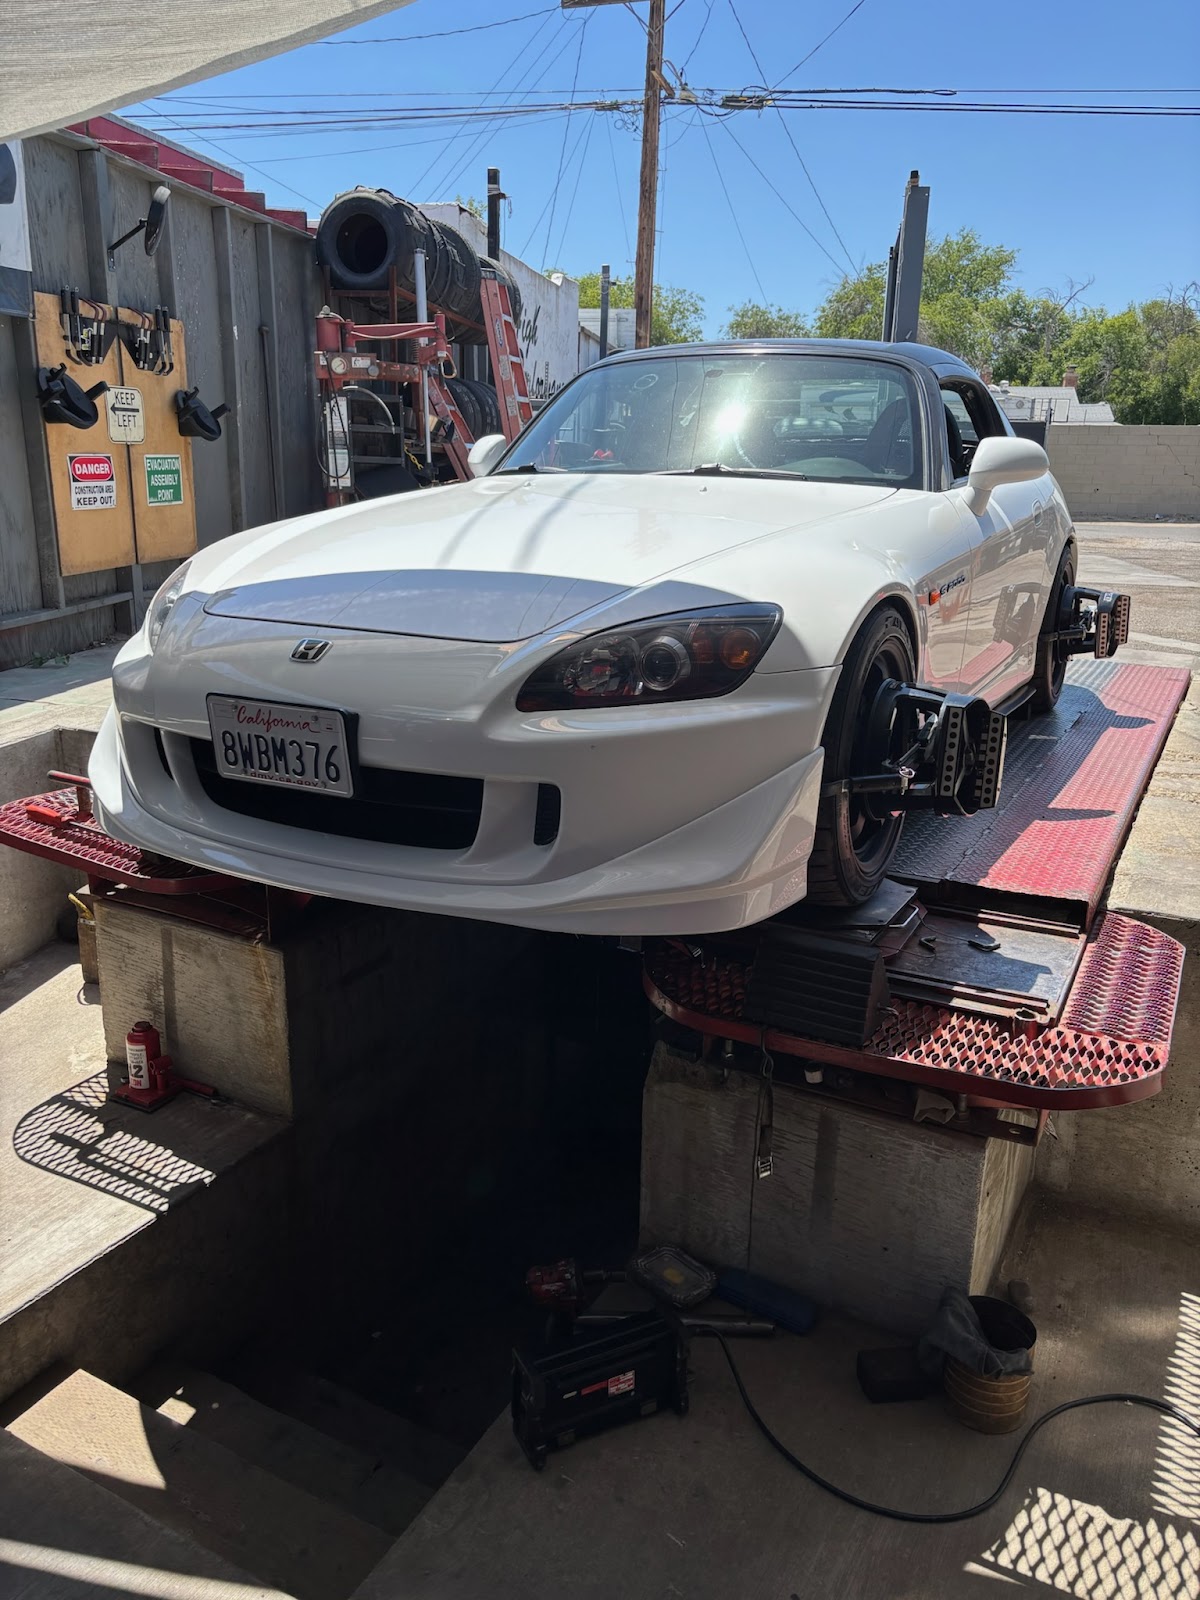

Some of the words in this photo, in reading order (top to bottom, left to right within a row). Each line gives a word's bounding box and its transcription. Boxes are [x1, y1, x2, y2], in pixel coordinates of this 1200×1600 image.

[114, 391, 136, 406] KEEP
[117, 414, 137, 428] LEFT
[74, 463, 110, 475] DANGER
[146, 458, 180, 471] EVACUATION
[150, 474, 178, 486] ASSEMBLY
[75, 485, 104, 495] CONSTRUCTION
[105, 484, 114, 494] AREA
[157, 489, 174, 501] POINT
[76, 496, 98, 506] KEEP
[99, 495, 113, 505] OUT
[237, 705, 320, 733] California
[221, 730, 341, 783] 8WBM376
[250, 772, 319, 788] dmv.ca.gov
